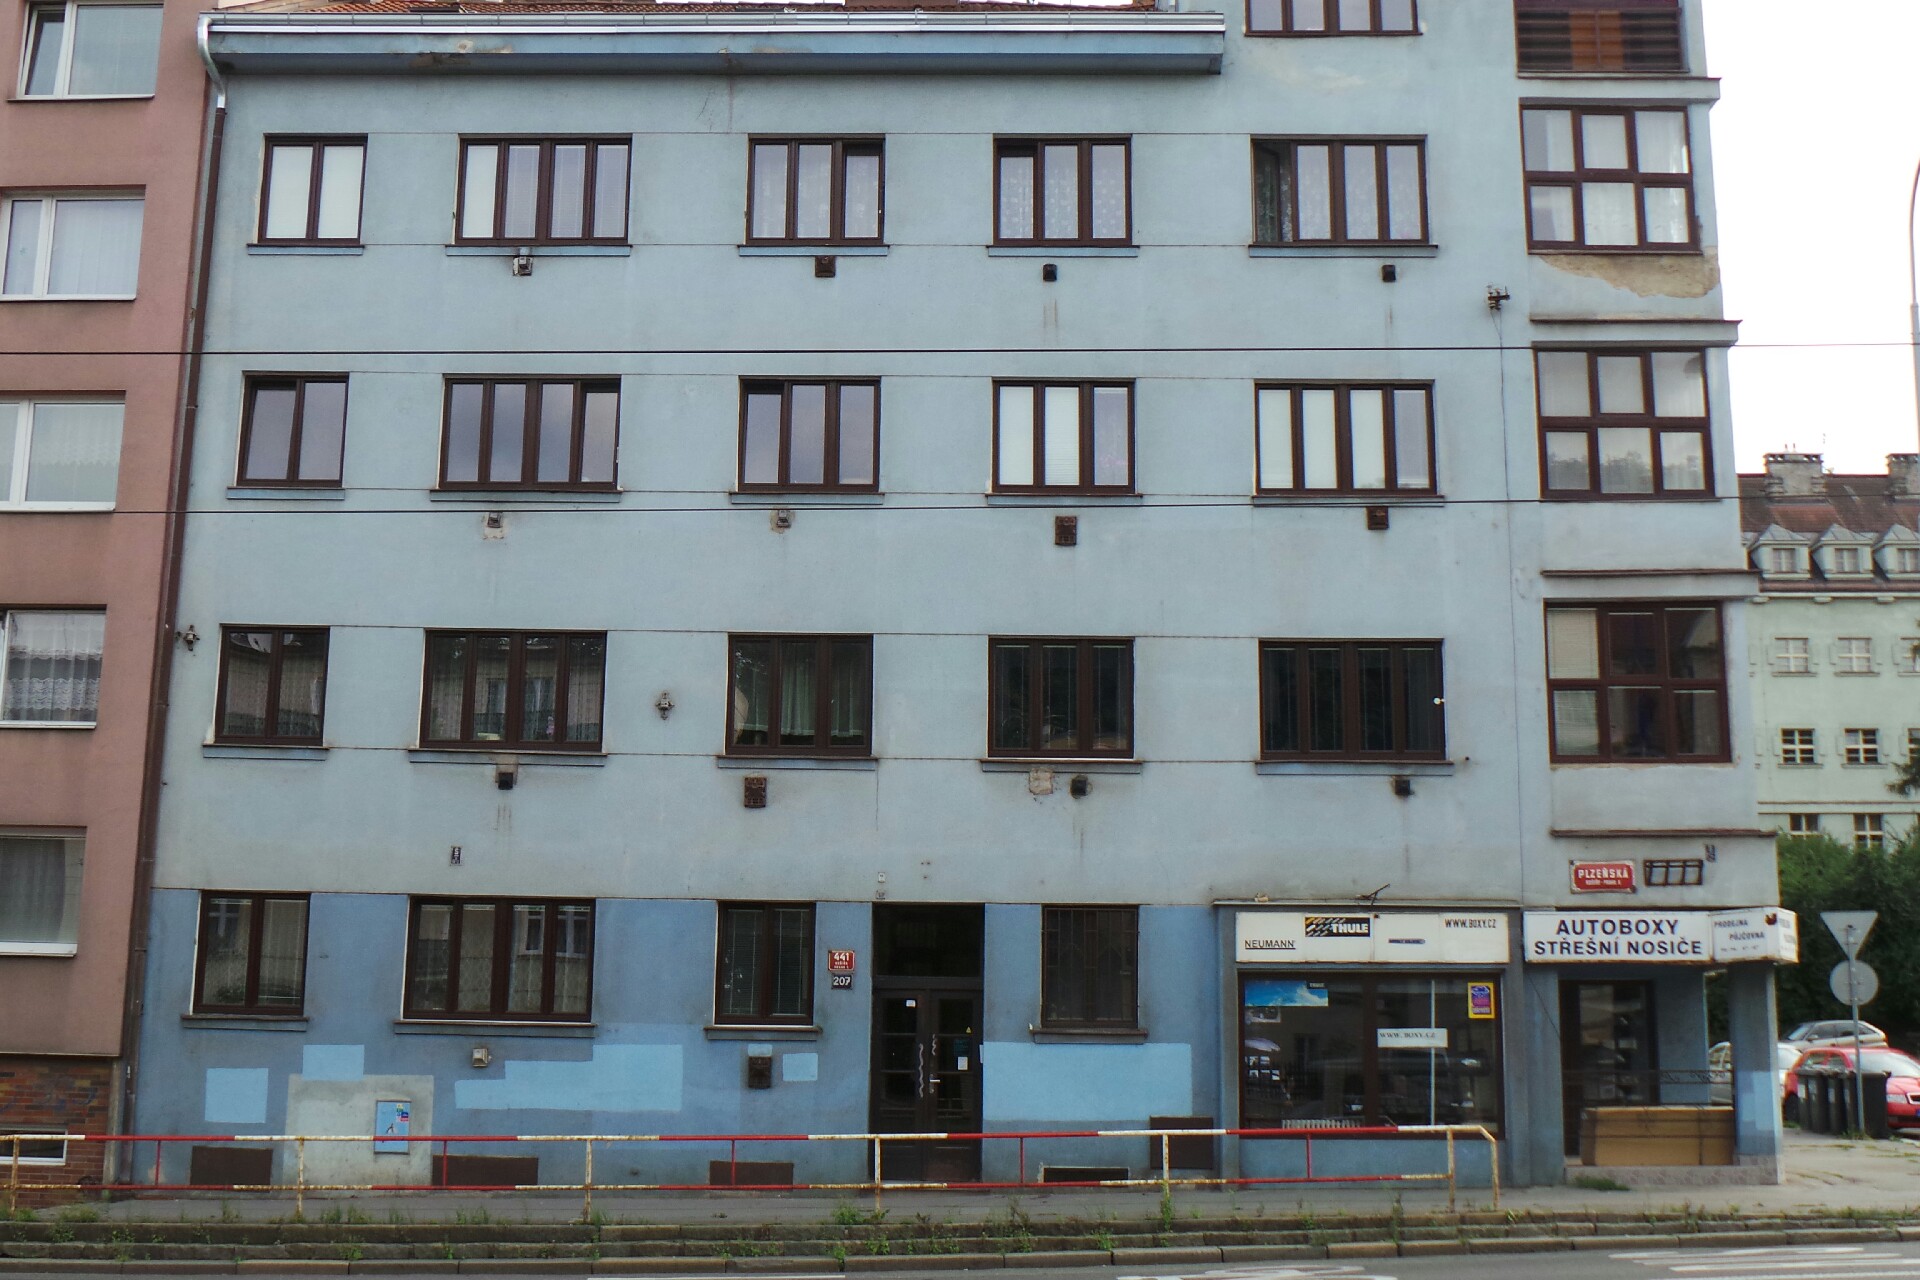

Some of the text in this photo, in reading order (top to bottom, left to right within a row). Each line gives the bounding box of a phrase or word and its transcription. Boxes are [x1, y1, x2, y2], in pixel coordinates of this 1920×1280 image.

[1578, 867, 1629, 879] PLZEŇSKÁ
[1444, 918, 1496, 928] WWW.BOXY.CZ
[1556, 919, 1679, 935] AUTOBOXY
[1714, 919, 1748, 928] PRODEJNA
[1331, 923, 1369, 934] THULE
[1244, 939, 1295, 949] NEUMANN
[1534, 936, 1703, 955] STŘEŠNÍ NOSIČE
[833, 952, 850, 961] 441
[833, 976, 851, 986] 207
